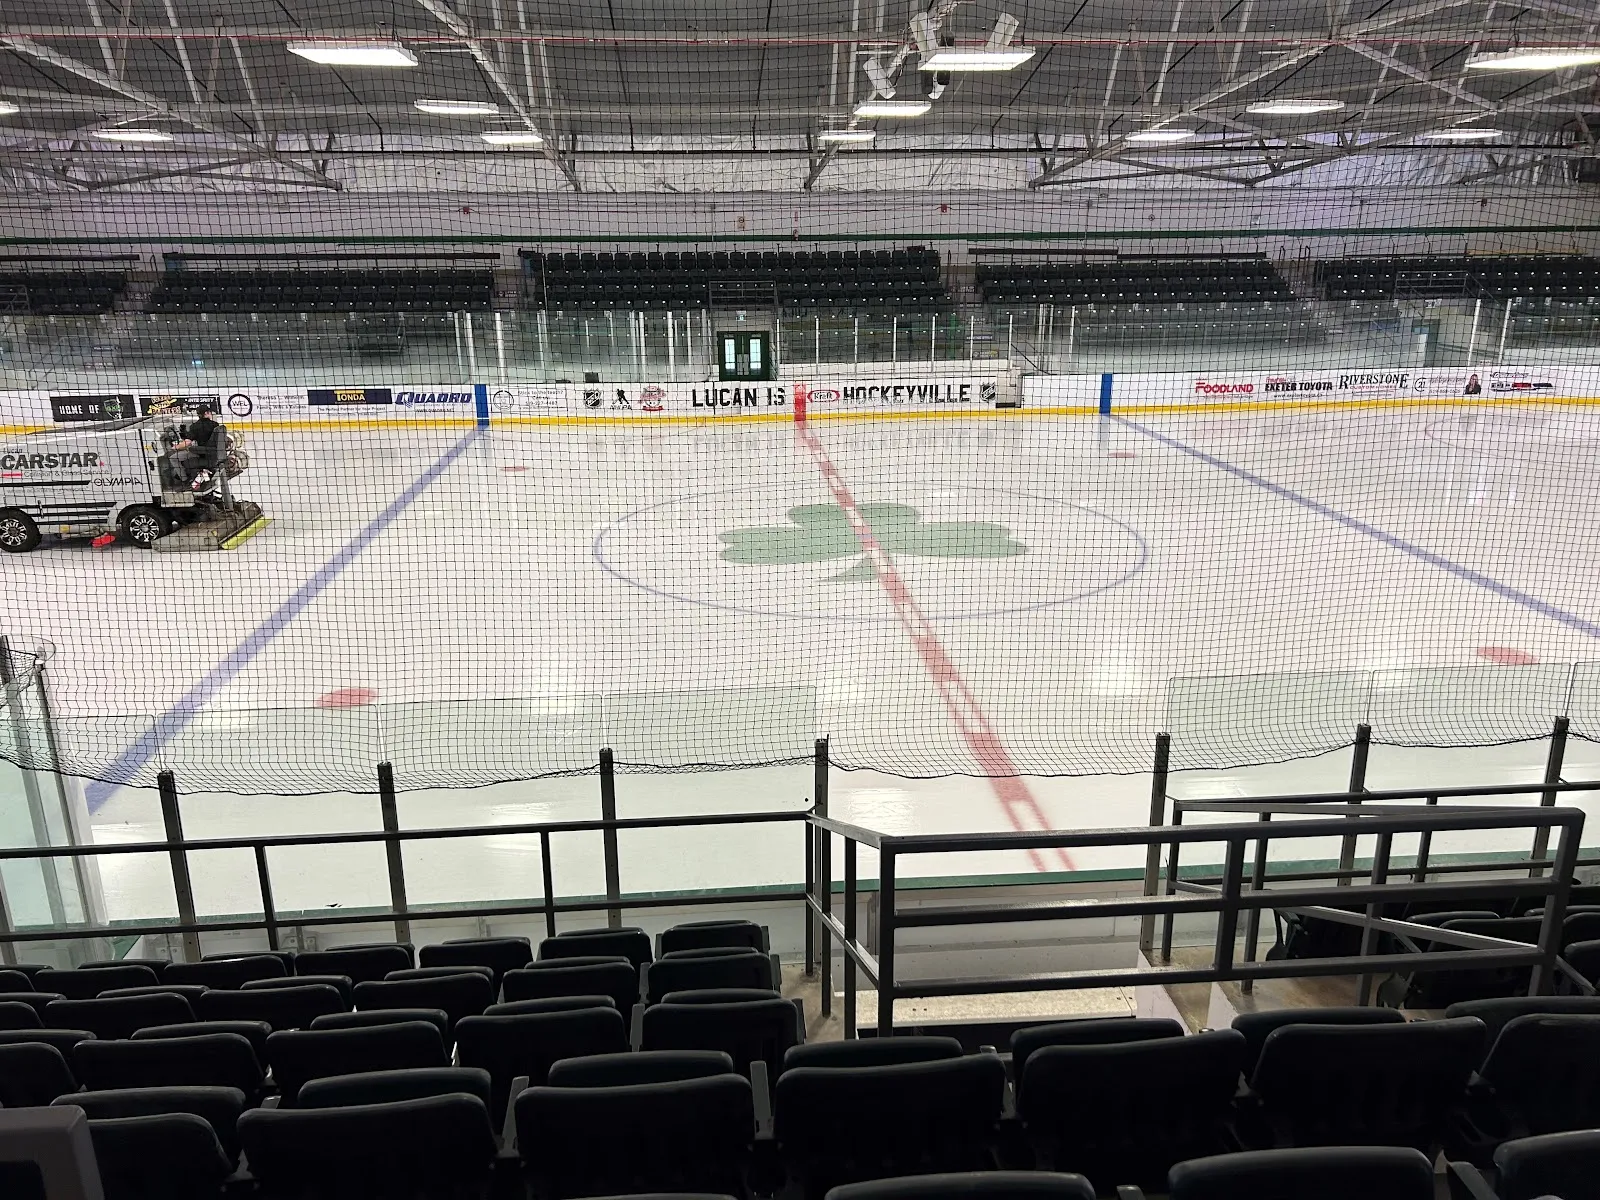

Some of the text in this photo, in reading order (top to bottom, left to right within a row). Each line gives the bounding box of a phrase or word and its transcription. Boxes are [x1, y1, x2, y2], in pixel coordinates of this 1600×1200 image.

[1195, 382, 1254, 394] FOODLAND
[1264, 381, 1333, 392] EXETER TOYOTA
[1338, 374, 1410, 389] RIVERSTONE
[333, 389, 366, 402] TONDA
[395, 392, 473, 406] QUADRO
[692, 387, 786, 407] LUCAN IS
[813, 392, 833, 400] Kraft
[843, 384, 971, 404] HOCKEYVILLE
[59, 404, 84, 415] HOME
[88, 404, 100, 414] OF
[1, 452, 98, 470] CARSTAR
[93, 477, 144, 487] OLYMPIA
